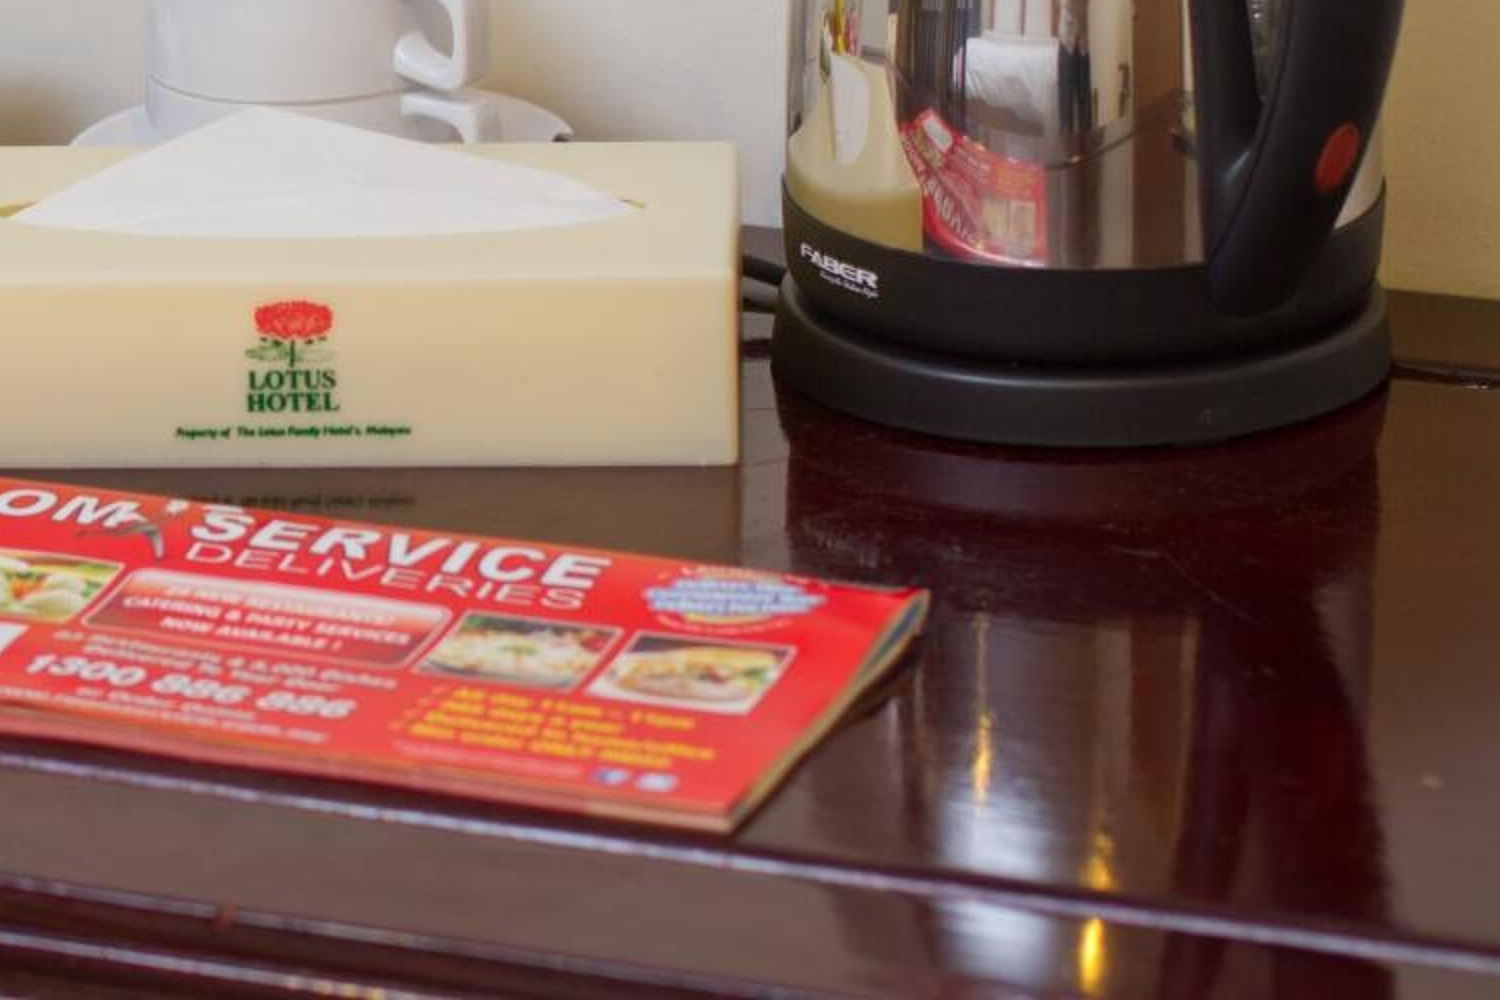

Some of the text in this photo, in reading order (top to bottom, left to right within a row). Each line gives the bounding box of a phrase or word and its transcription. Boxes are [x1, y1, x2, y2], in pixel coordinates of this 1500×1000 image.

[800, 242, 878, 288] FABER
[248, 369, 337, 391] LOTUS
[246, 391, 341, 413] HOTEL
[236, 425, 256, 437] The
[189, 507, 613, 590] SERVICE
[185, 541, 587, 610] DELIVERIES
[122, 596, 412, 646] CATERING & PARTY SERVICES
[159, 615, 214, 634] NOW
[214, 623, 329, 650] AVAILABLE
[25, 653, 147, 687] 1300
